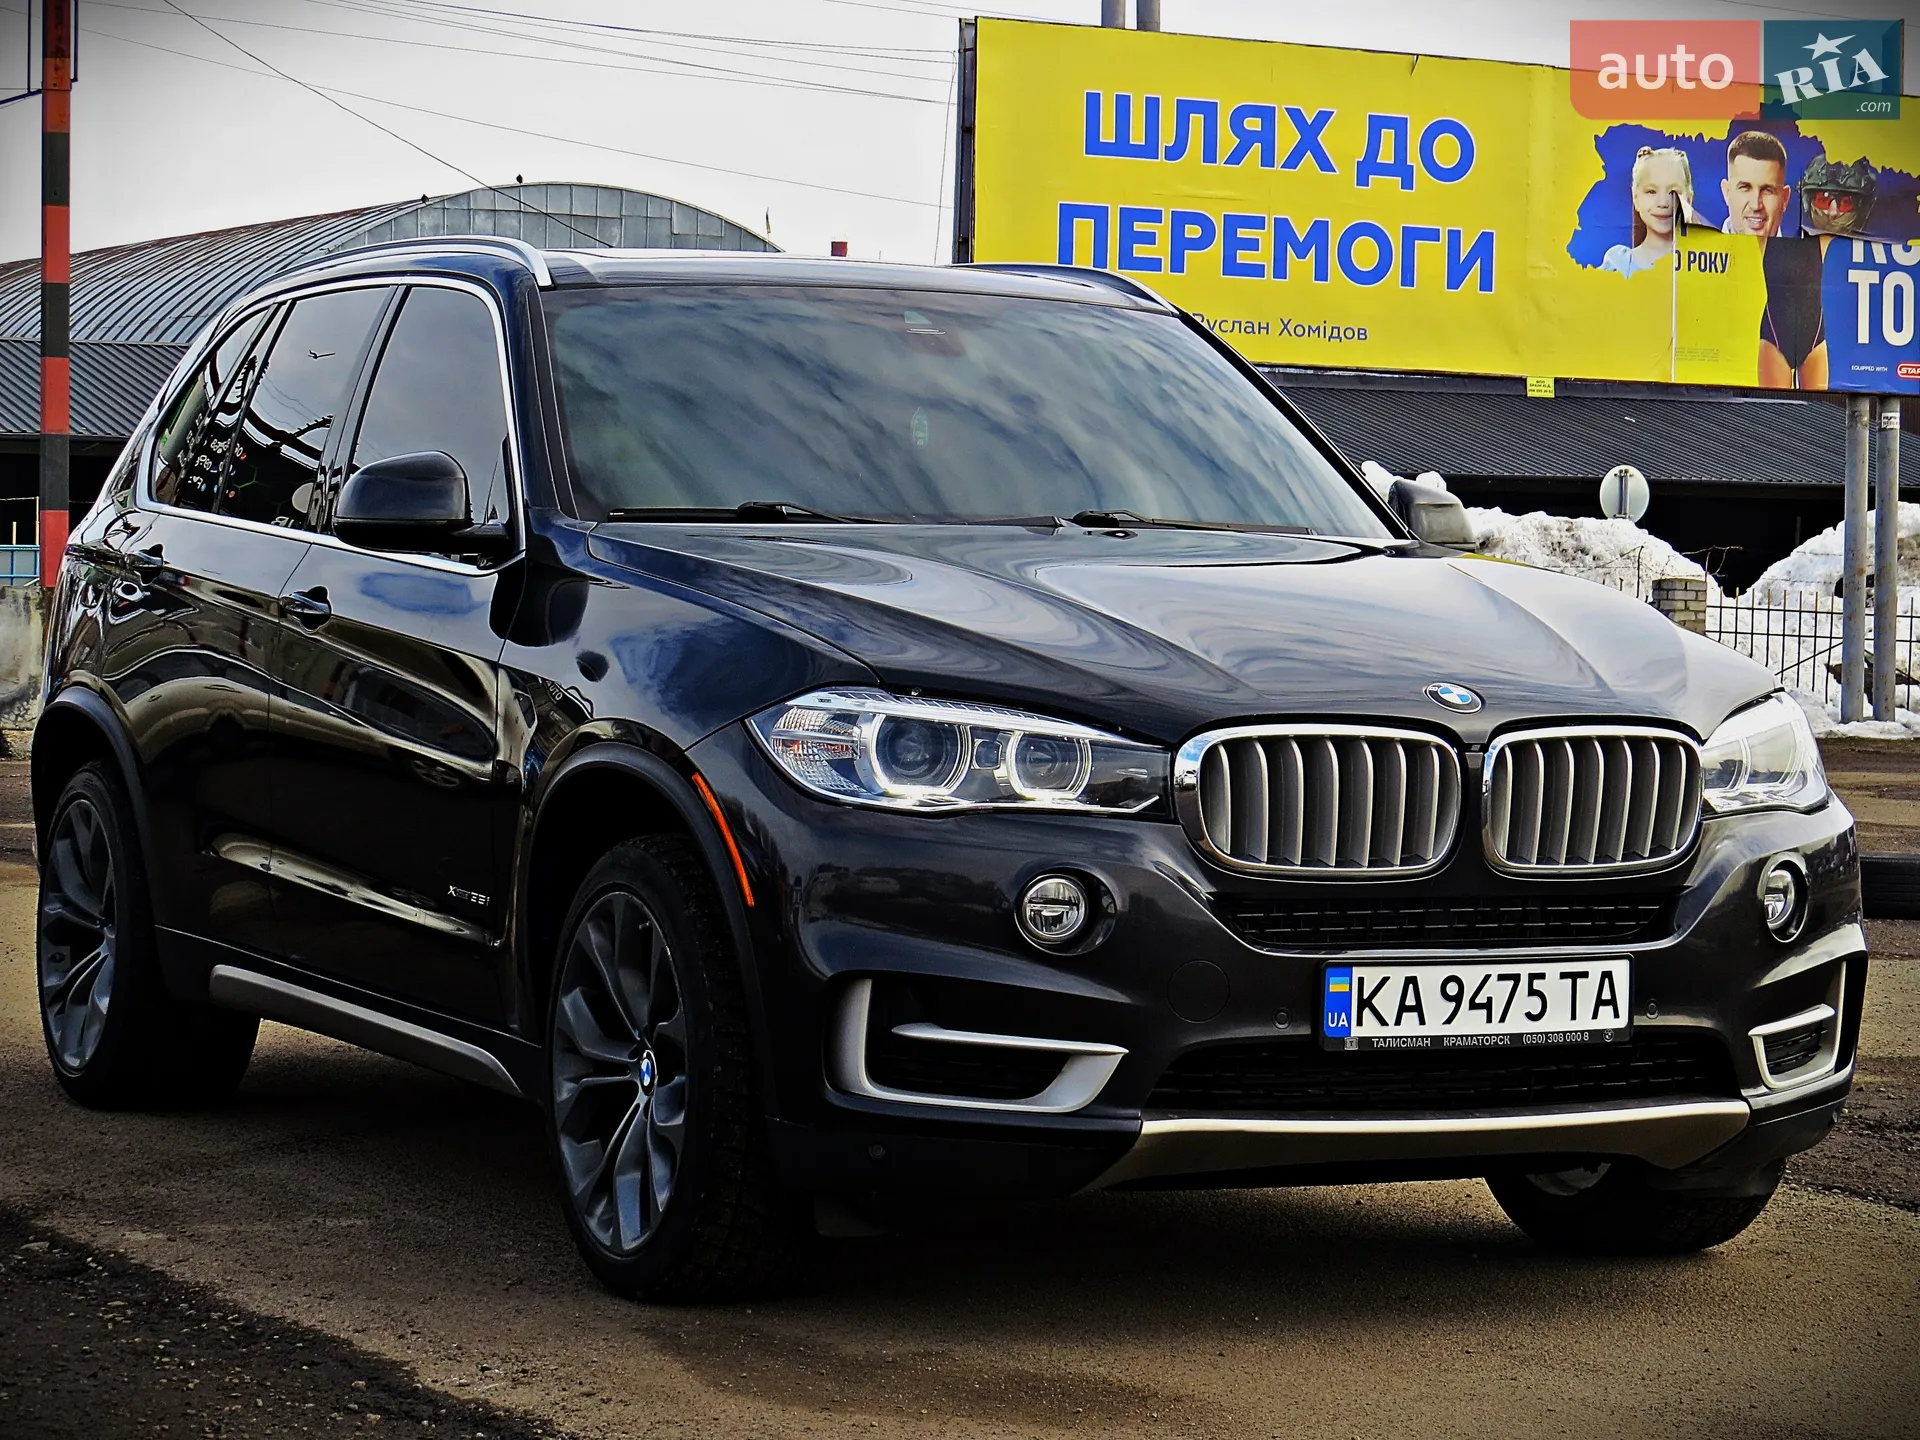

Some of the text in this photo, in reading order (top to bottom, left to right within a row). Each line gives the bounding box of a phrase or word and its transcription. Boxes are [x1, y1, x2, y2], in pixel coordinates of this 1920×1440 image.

[1084, 90, 1475, 191] ШЛЯХ ДО
[1057, 202, 1495, 293] ПЕРЕМОГИ
[1687, 250, 1729, 274] РОКУ
[1278, 317, 1368, 343] Хомідов
[1356, 970, 1620, 1027] KA 9475 TA
[1328, 1011, 1349, 1028] UA
[1371, 1037, 1431, 1048] ТАЛИСМАН
[1443, 1035, 1511, 1047] КРАМАТОРСК
[1522, 1033, 1546, 1044] (050)
[1547, 1032, 1564, 1043] 308
[1565, 1031, 1582, 1042] 000
[1583, 1031, 1590, 1041] 8
